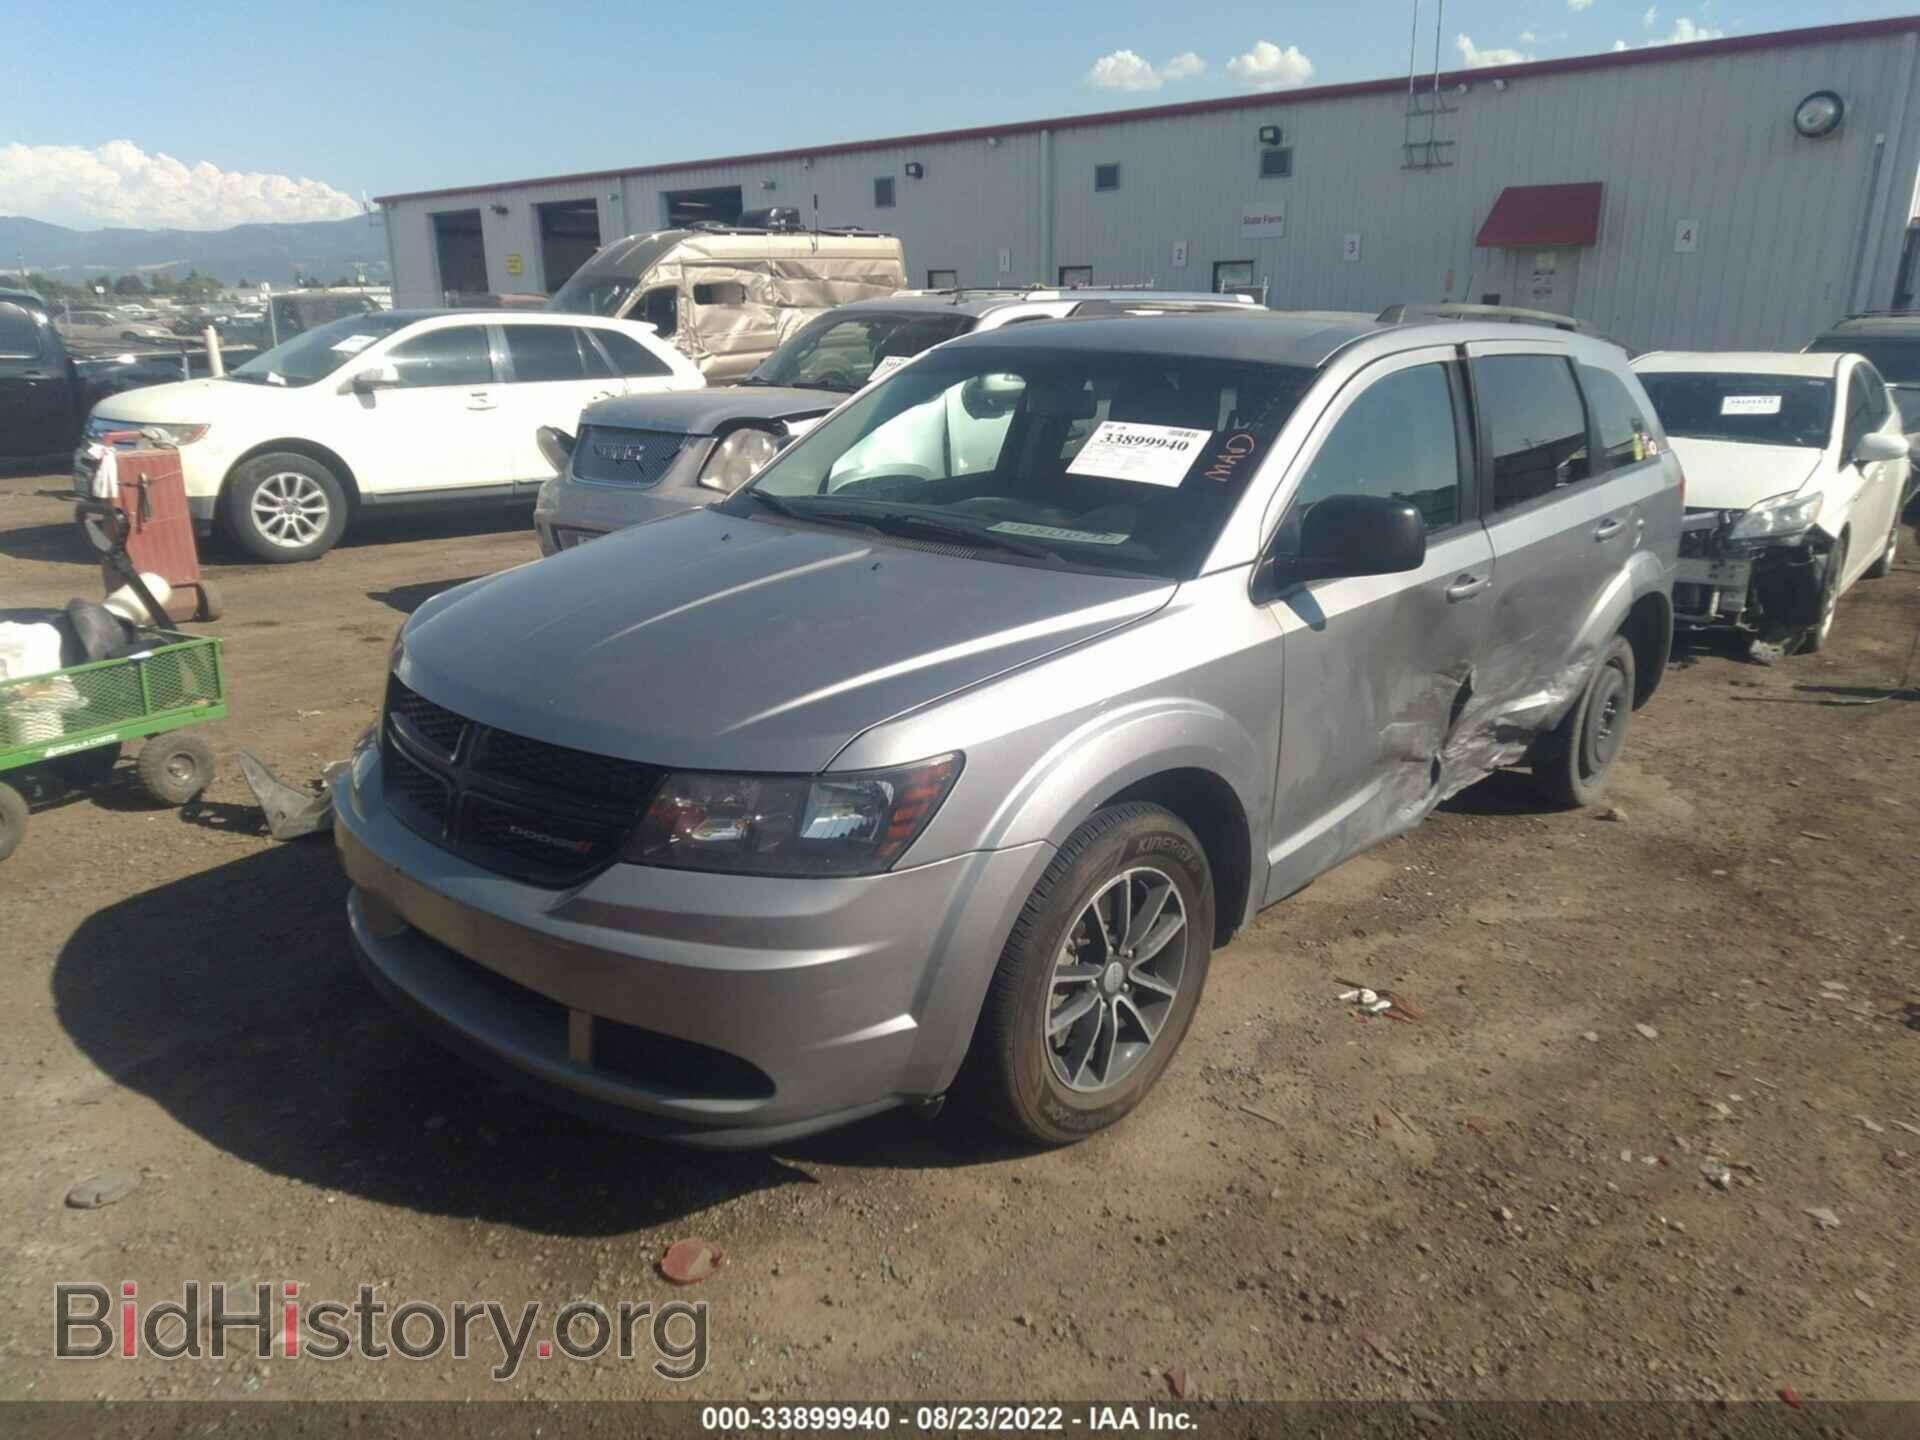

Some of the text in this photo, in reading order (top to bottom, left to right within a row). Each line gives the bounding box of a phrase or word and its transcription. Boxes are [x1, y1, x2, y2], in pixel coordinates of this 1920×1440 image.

[1243, 214, 1283, 225] State Farm
[1681, 229, 1691, 243] 4
[1349, 240, 1356, 253] 3
[1176, 248, 1183, 260] 2
[1100, 432, 1190, 452] 33899940
